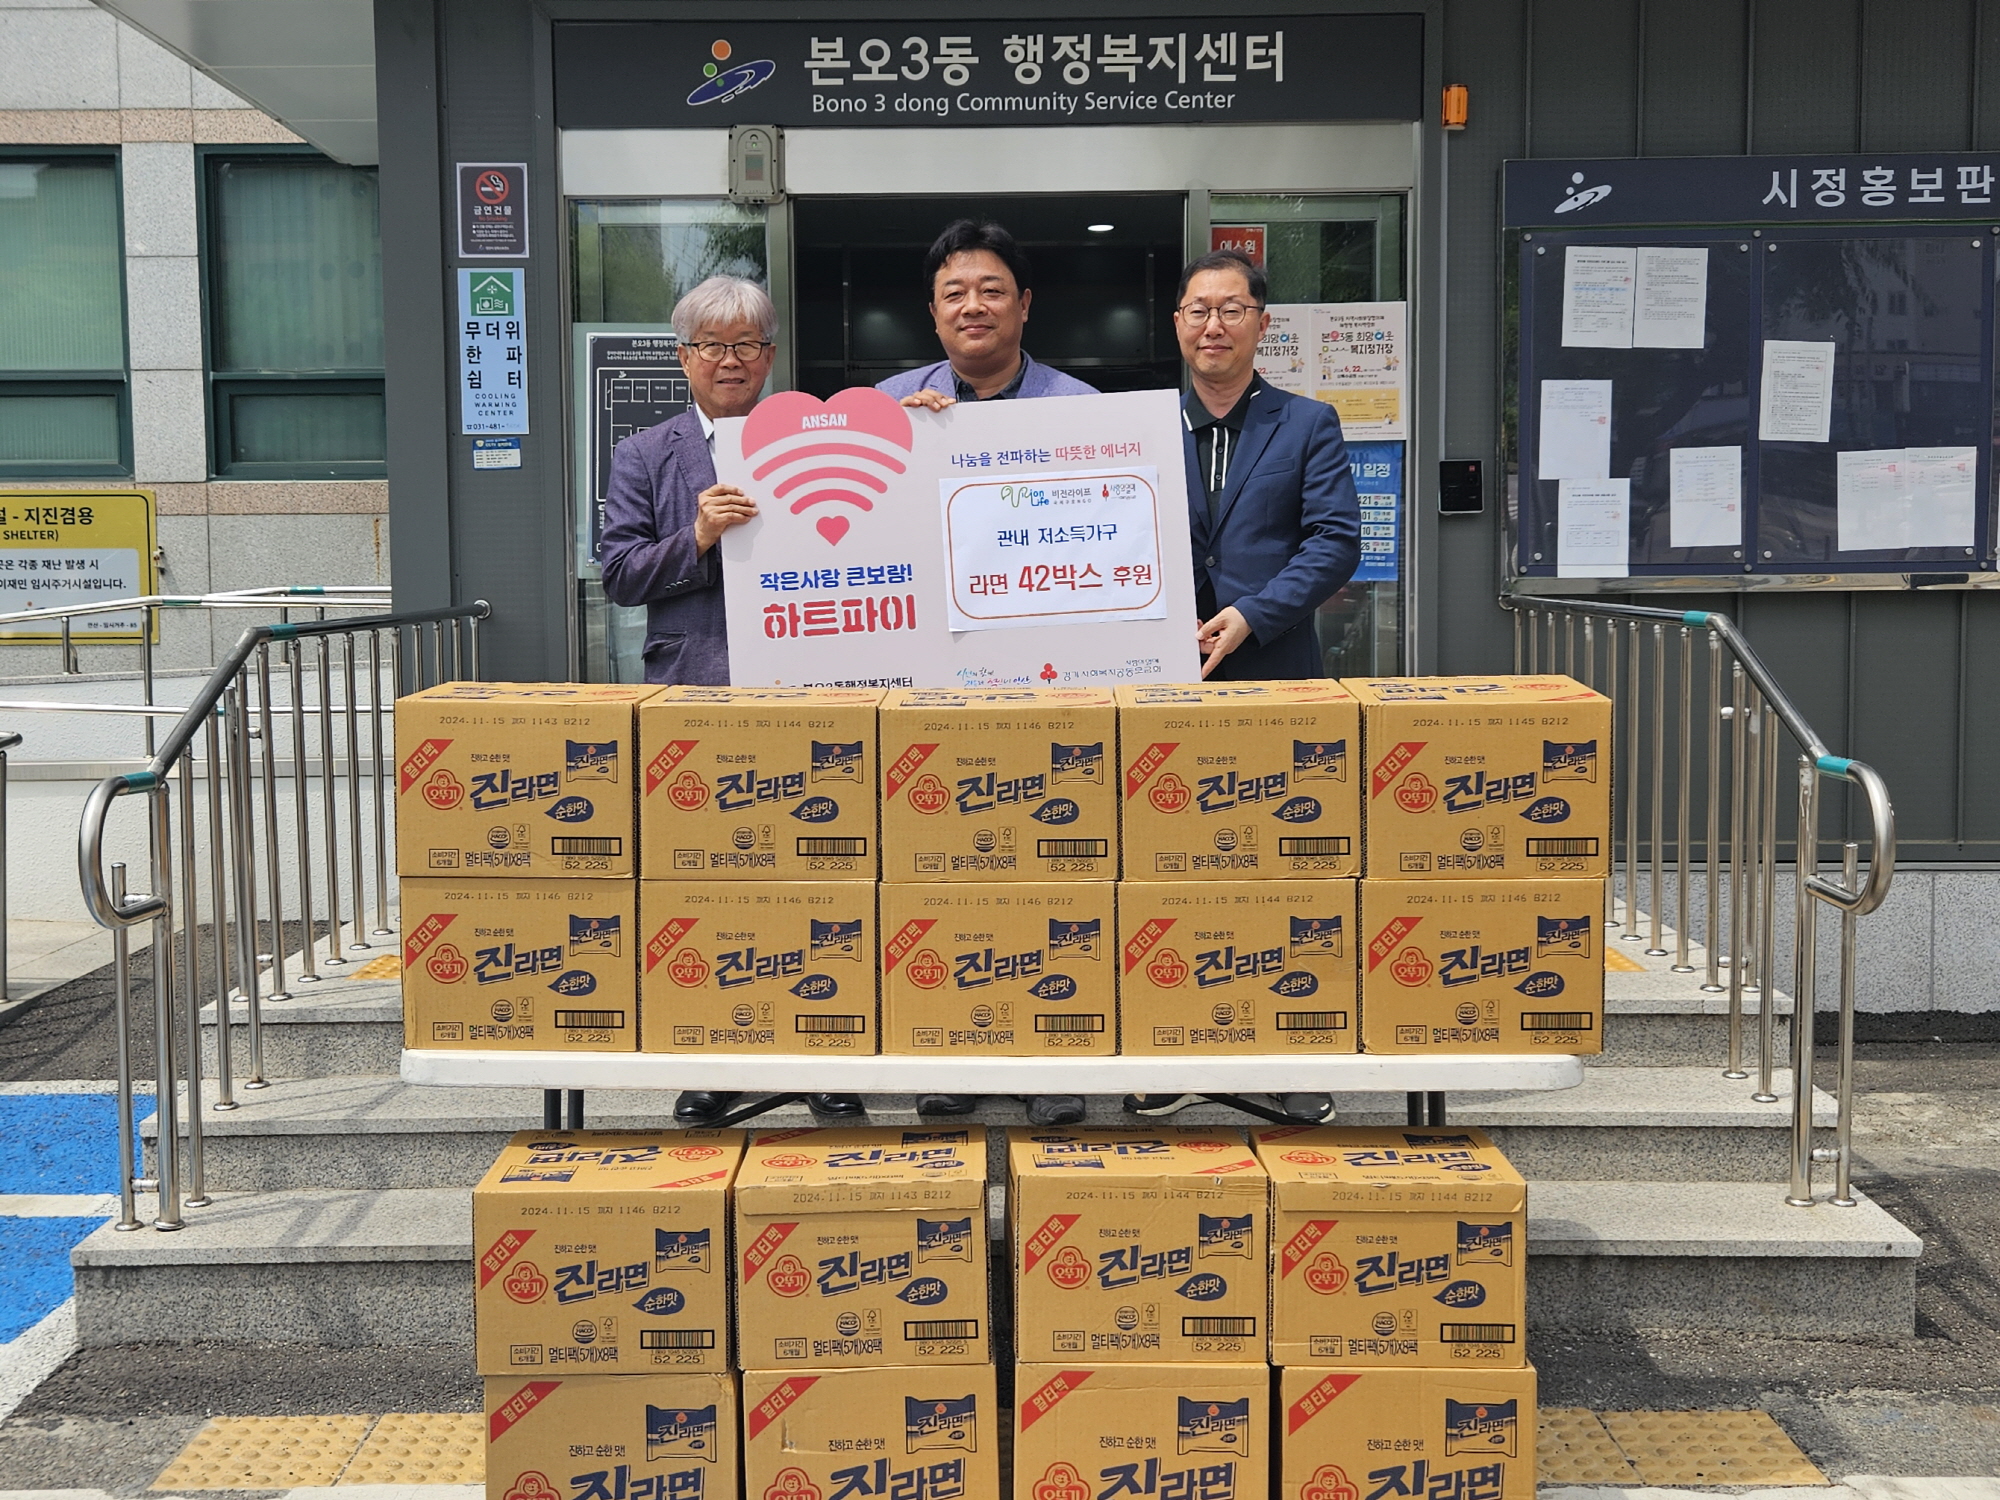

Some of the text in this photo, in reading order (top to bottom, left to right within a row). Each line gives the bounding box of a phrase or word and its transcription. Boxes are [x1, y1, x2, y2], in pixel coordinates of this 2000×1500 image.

[804, 31, 1284, 86] 본오3동 행정복지센터
[812, 90, 1236, 117] Bono 3 dong Community Service Center
[801, 413, 847, 430] ANSAN
[950, 442, 1142, 469] 나눔을 전파하는 따뜻한 에너지
[1363, 463, 1391, 477] 일정
[1052, 487, 1092, 499] 비전라이프
[24, 506, 94, 525] 지진겸용
[3, 529, 59, 542] SHELTER)
[997, 523, 1118, 547] 관내 저소득가구
[18, 559, 38, 570] 각종
[42, 559, 62, 570] 재난
[65, 559, 86, 570] 발생
[89, 559, 99, 570] 시
[30, 578, 127, 590] 임시주거시설입니다.
[760, 562, 913, 592] 작은사랑 큰보람!
[969, 562, 1152, 596] 라면 42박스 후원
[763, 593, 917, 640] 하트파이
[403, 742, 439, 776] 멀티팩
[649, 744, 684, 778] 멀티팩
[889, 748, 925, 782] 멀티팩
[1129, 747, 1165, 781] 멀티팩
[1376, 746, 1412, 780] 멀티팩
[430, 788, 457, 800] 오뚜기
[470, 768, 561, 811] 진라면
[675, 789, 702, 802] 오뚜기
[715, 769, 806, 812] 진라면
[916, 792, 943, 805] 오뚜기
[956, 772, 1046, 814] 진라면
[1156, 791, 1184, 804] 오뚜기
[1196, 770, 1288, 813] 진라면
[1402, 791, 1430, 804] 오뚜기
[1443, 770, 1537, 813] 진라면
[555, 801, 587, 819] 순한맛
[800, 801, 832, 820] 순한맛
[1041, 803, 1073, 821] 순한맛
[1282, 801, 1315, 820] 순한맛
[1531, 802, 1564, 820] 순한맛
[407, 917, 443, 951] 멀티팩
[649, 921, 685, 955] 멀티팩
[888, 923, 923, 957] 멀티팩
[1127, 922, 1163, 956] 멀티팩
[1371, 920, 1408, 954] 멀티팩
[434, 962, 461, 974] 오뚜기
[474, 943, 564, 985] 진라면
[675, 966, 702, 978] 오뚜기
[715, 947, 805, 989] 진라면
[914, 967, 941, 980] 오뚜기
[954, 947, 1044, 990] 진라면
[1154, 966, 1181, 979] 오뚜기
[1194, 945, 1285, 988] 진라면
[1398, 965, 1426, 978] 오뚜기
[1439, 945, 1532, 987] 진라면
[558, 974, 590, 993] 순한맛
[799, 979, 831, 997] 순한맛
[1038, 979, 1070, 997] 순한맛
[1279, 976, 1312, 994] 순한맛
[1525, 976, 1558, 994] 순한맛
[823, 1147, 956, 1167] 진라면
[1343, 1150, 1474, 1166] 진라면
[746, 1227, 784, 1263] 멀티팩
[1028, 1218, 1066, 1254] 멀티팩
[1285, 1224, 1322, 1260] 멀티팩
[483, 1234, 521, 1269] 멀티팩
[817, 1250, 913, 1295] 진라면
[1055, 1266, 1084, 1279] 오뚜기
[1097, 1244, 1193, 1290] 진라면
[1312, 1271, 1341, 1285] 오뚜기
[1354, 1251, 1451, 1296] 진라면
[511, 1280, 540, 1294] 오뚜기
[554, 1259, 650, 1304] 진라면
[775, 1274, 804, 1287] 오뚜기
[907, 1282, 941, 1302] 순한맛
[1186, 1278, 1220, 1298] 순한맛
[644, 1292, 678, 1312] 순한맛
[1445, 1285, 1479, 1304] 순한맛
[501, 1387, 539, 1423] 멀티팩
[760, 1383, 797, 1419] 멀티팩
[1032, 1378, 1069, 1412] 멀티팩
[1300, 1380, 1337, 1415] 멀티팩
[1099, 1436, 1125, 1449] 진하고
[1126, 1436, 1144, 1449] 순한
